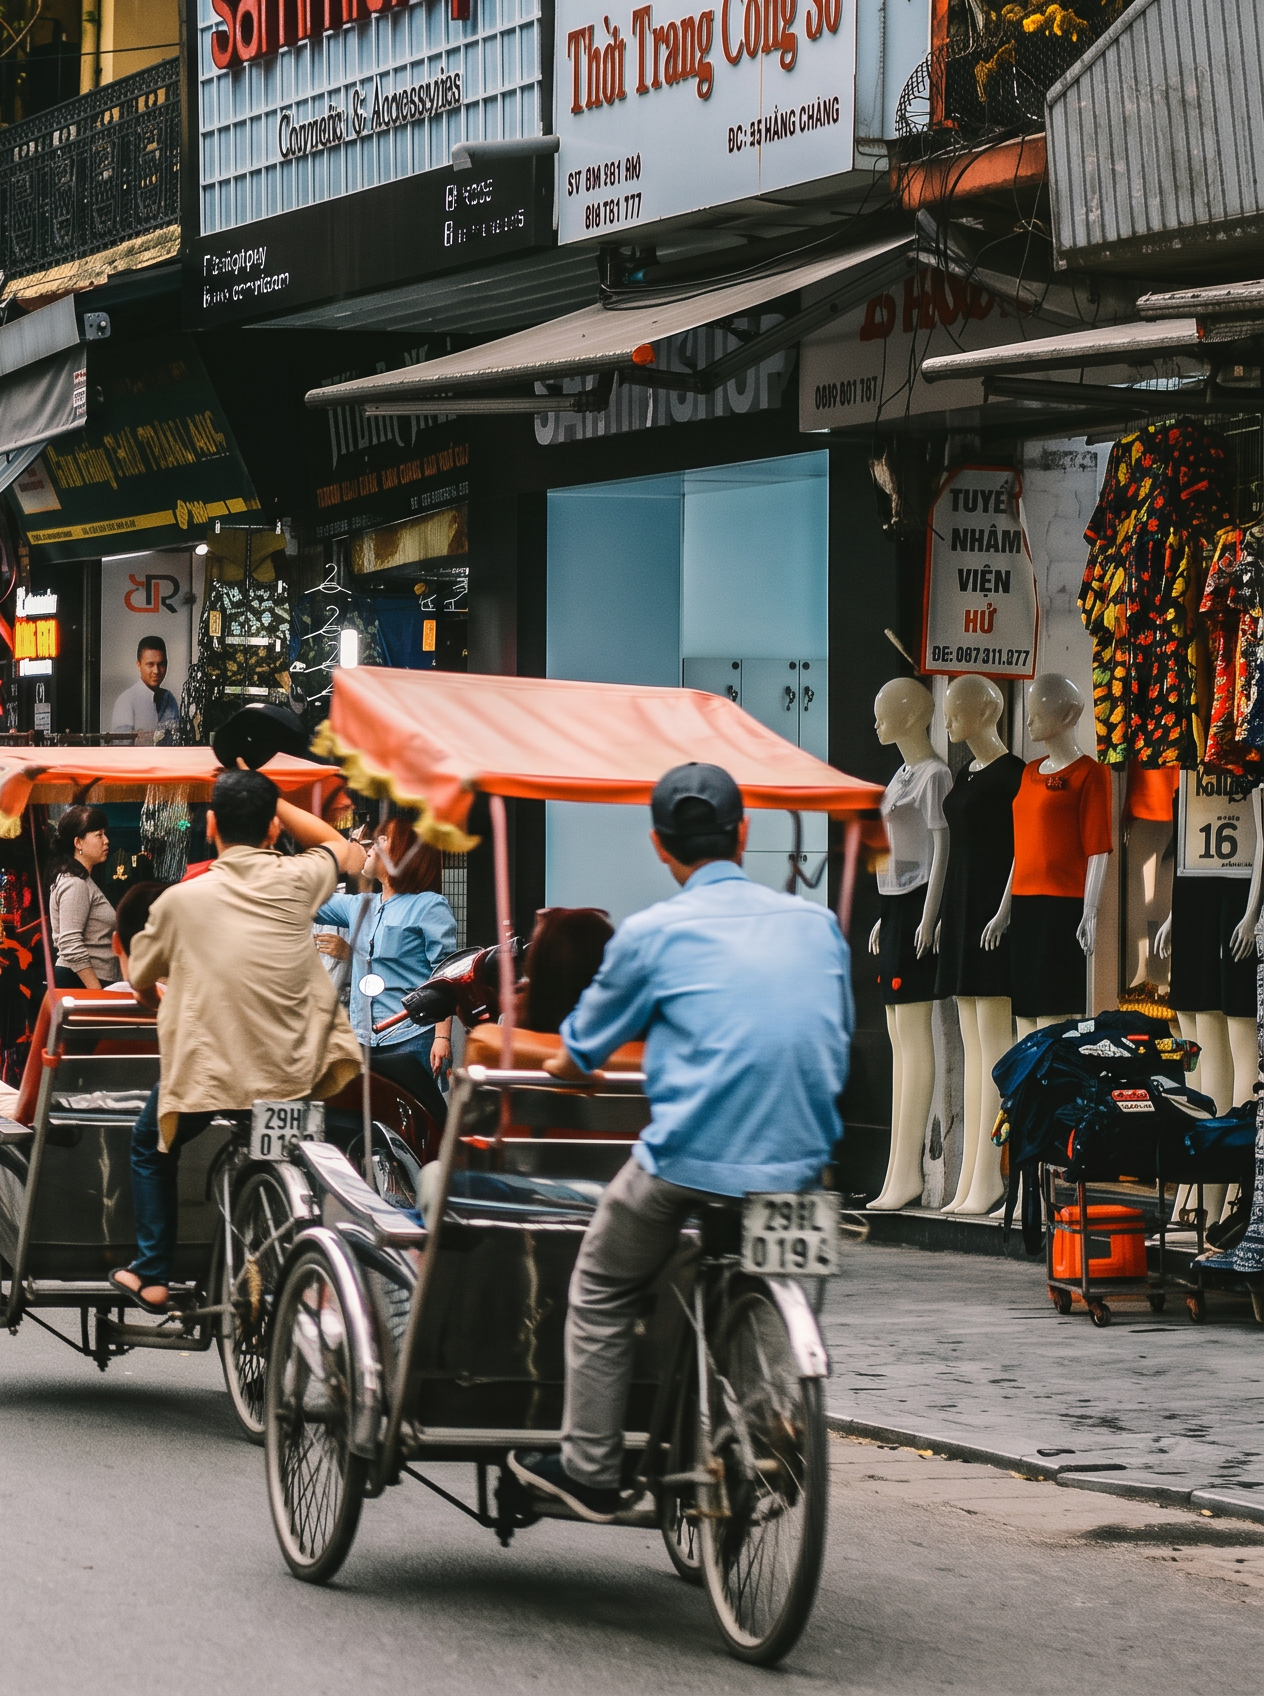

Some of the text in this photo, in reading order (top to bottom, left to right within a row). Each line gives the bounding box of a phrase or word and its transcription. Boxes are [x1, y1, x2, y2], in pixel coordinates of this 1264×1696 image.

[632, 4, 714, 99] Trang
[957, 563, 1011, 598] VIỆN
[1198, 821, 1239, 860] 16
[264, 1107, 302, 1130] 29H
